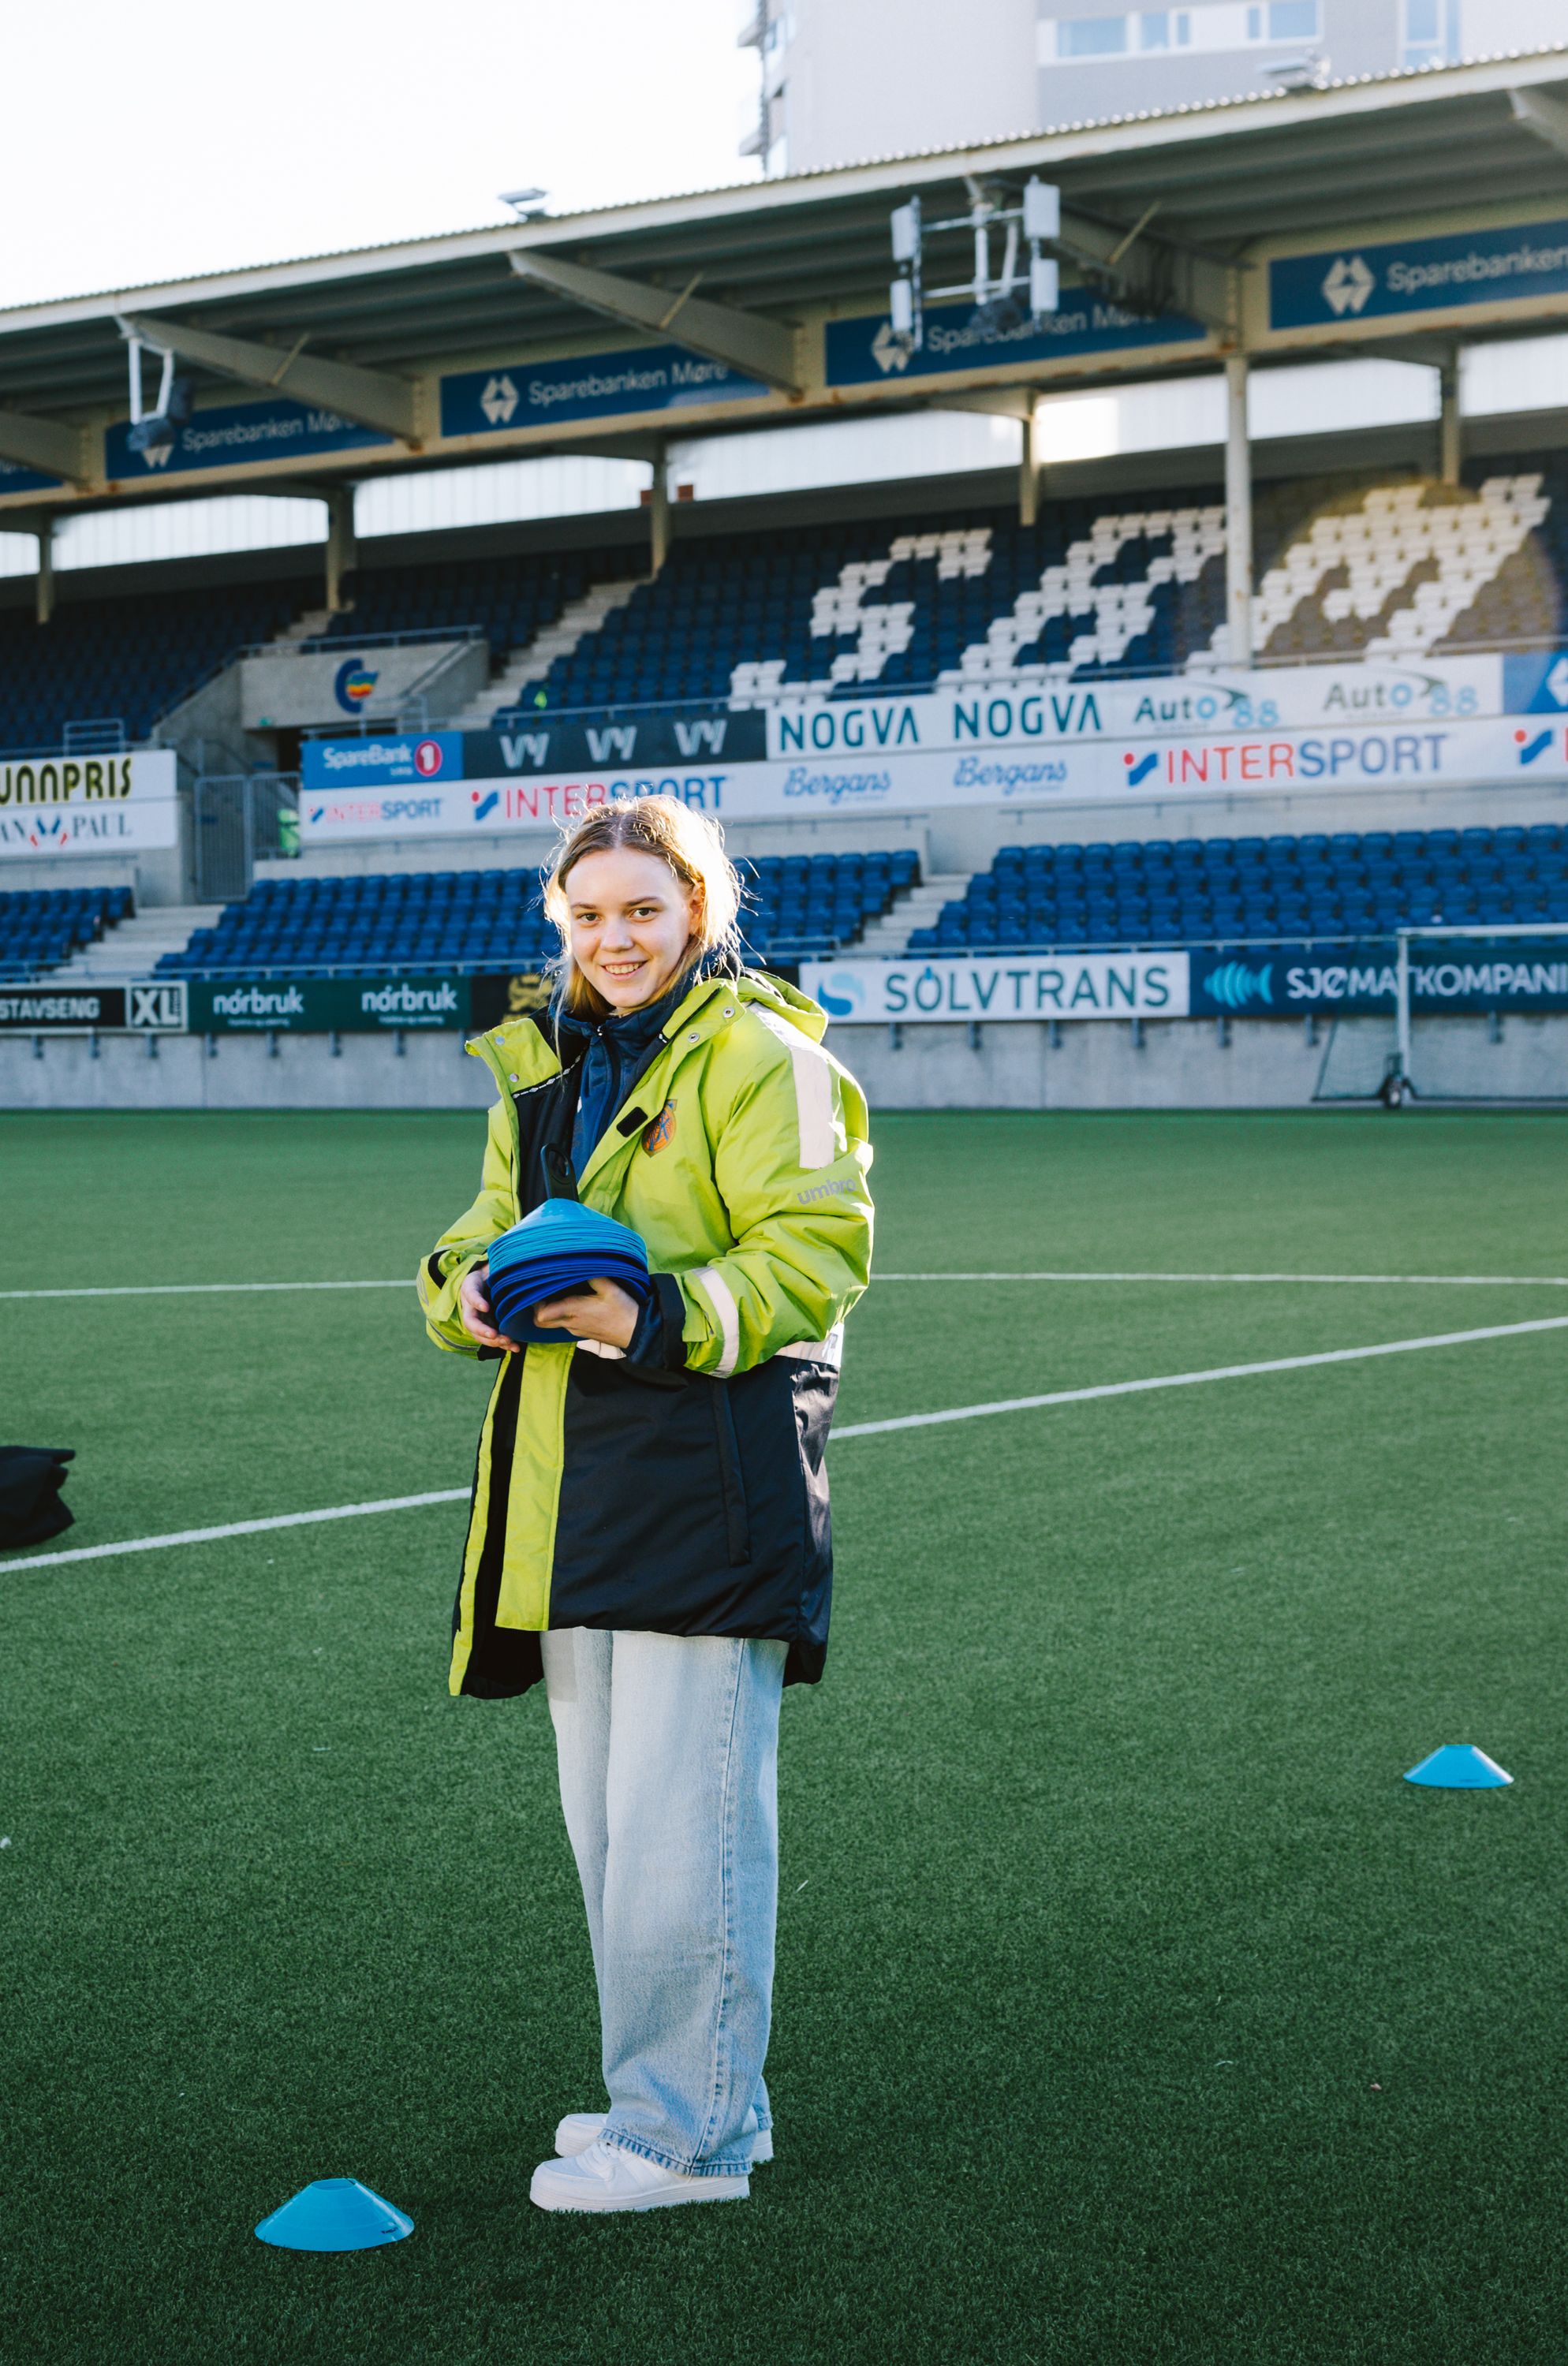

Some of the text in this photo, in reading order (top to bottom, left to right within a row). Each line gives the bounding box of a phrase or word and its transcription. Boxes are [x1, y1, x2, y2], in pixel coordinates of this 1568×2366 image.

[1387, 244, 1568, 295] Sparebanken
[528, 361, 728, 408] Sparebanken Møre
[182, 412, 304, 453] Sparebanken
[779, 706, 919, 752] NOGVA
[954, 693, 1102, 740] NOGVA
[323, 743, 412, 771] SpareBank
[953, 755, 1068, 796] Bergans
[1167, 733, 1448, 784] INTERSPORT
[782, 766, 892, 805] Bergans
[326, 797, 443, 822] INTERSPORT
[133, 988, 178, 1026] XL
[797, 1177, 857, 1205] umbro
